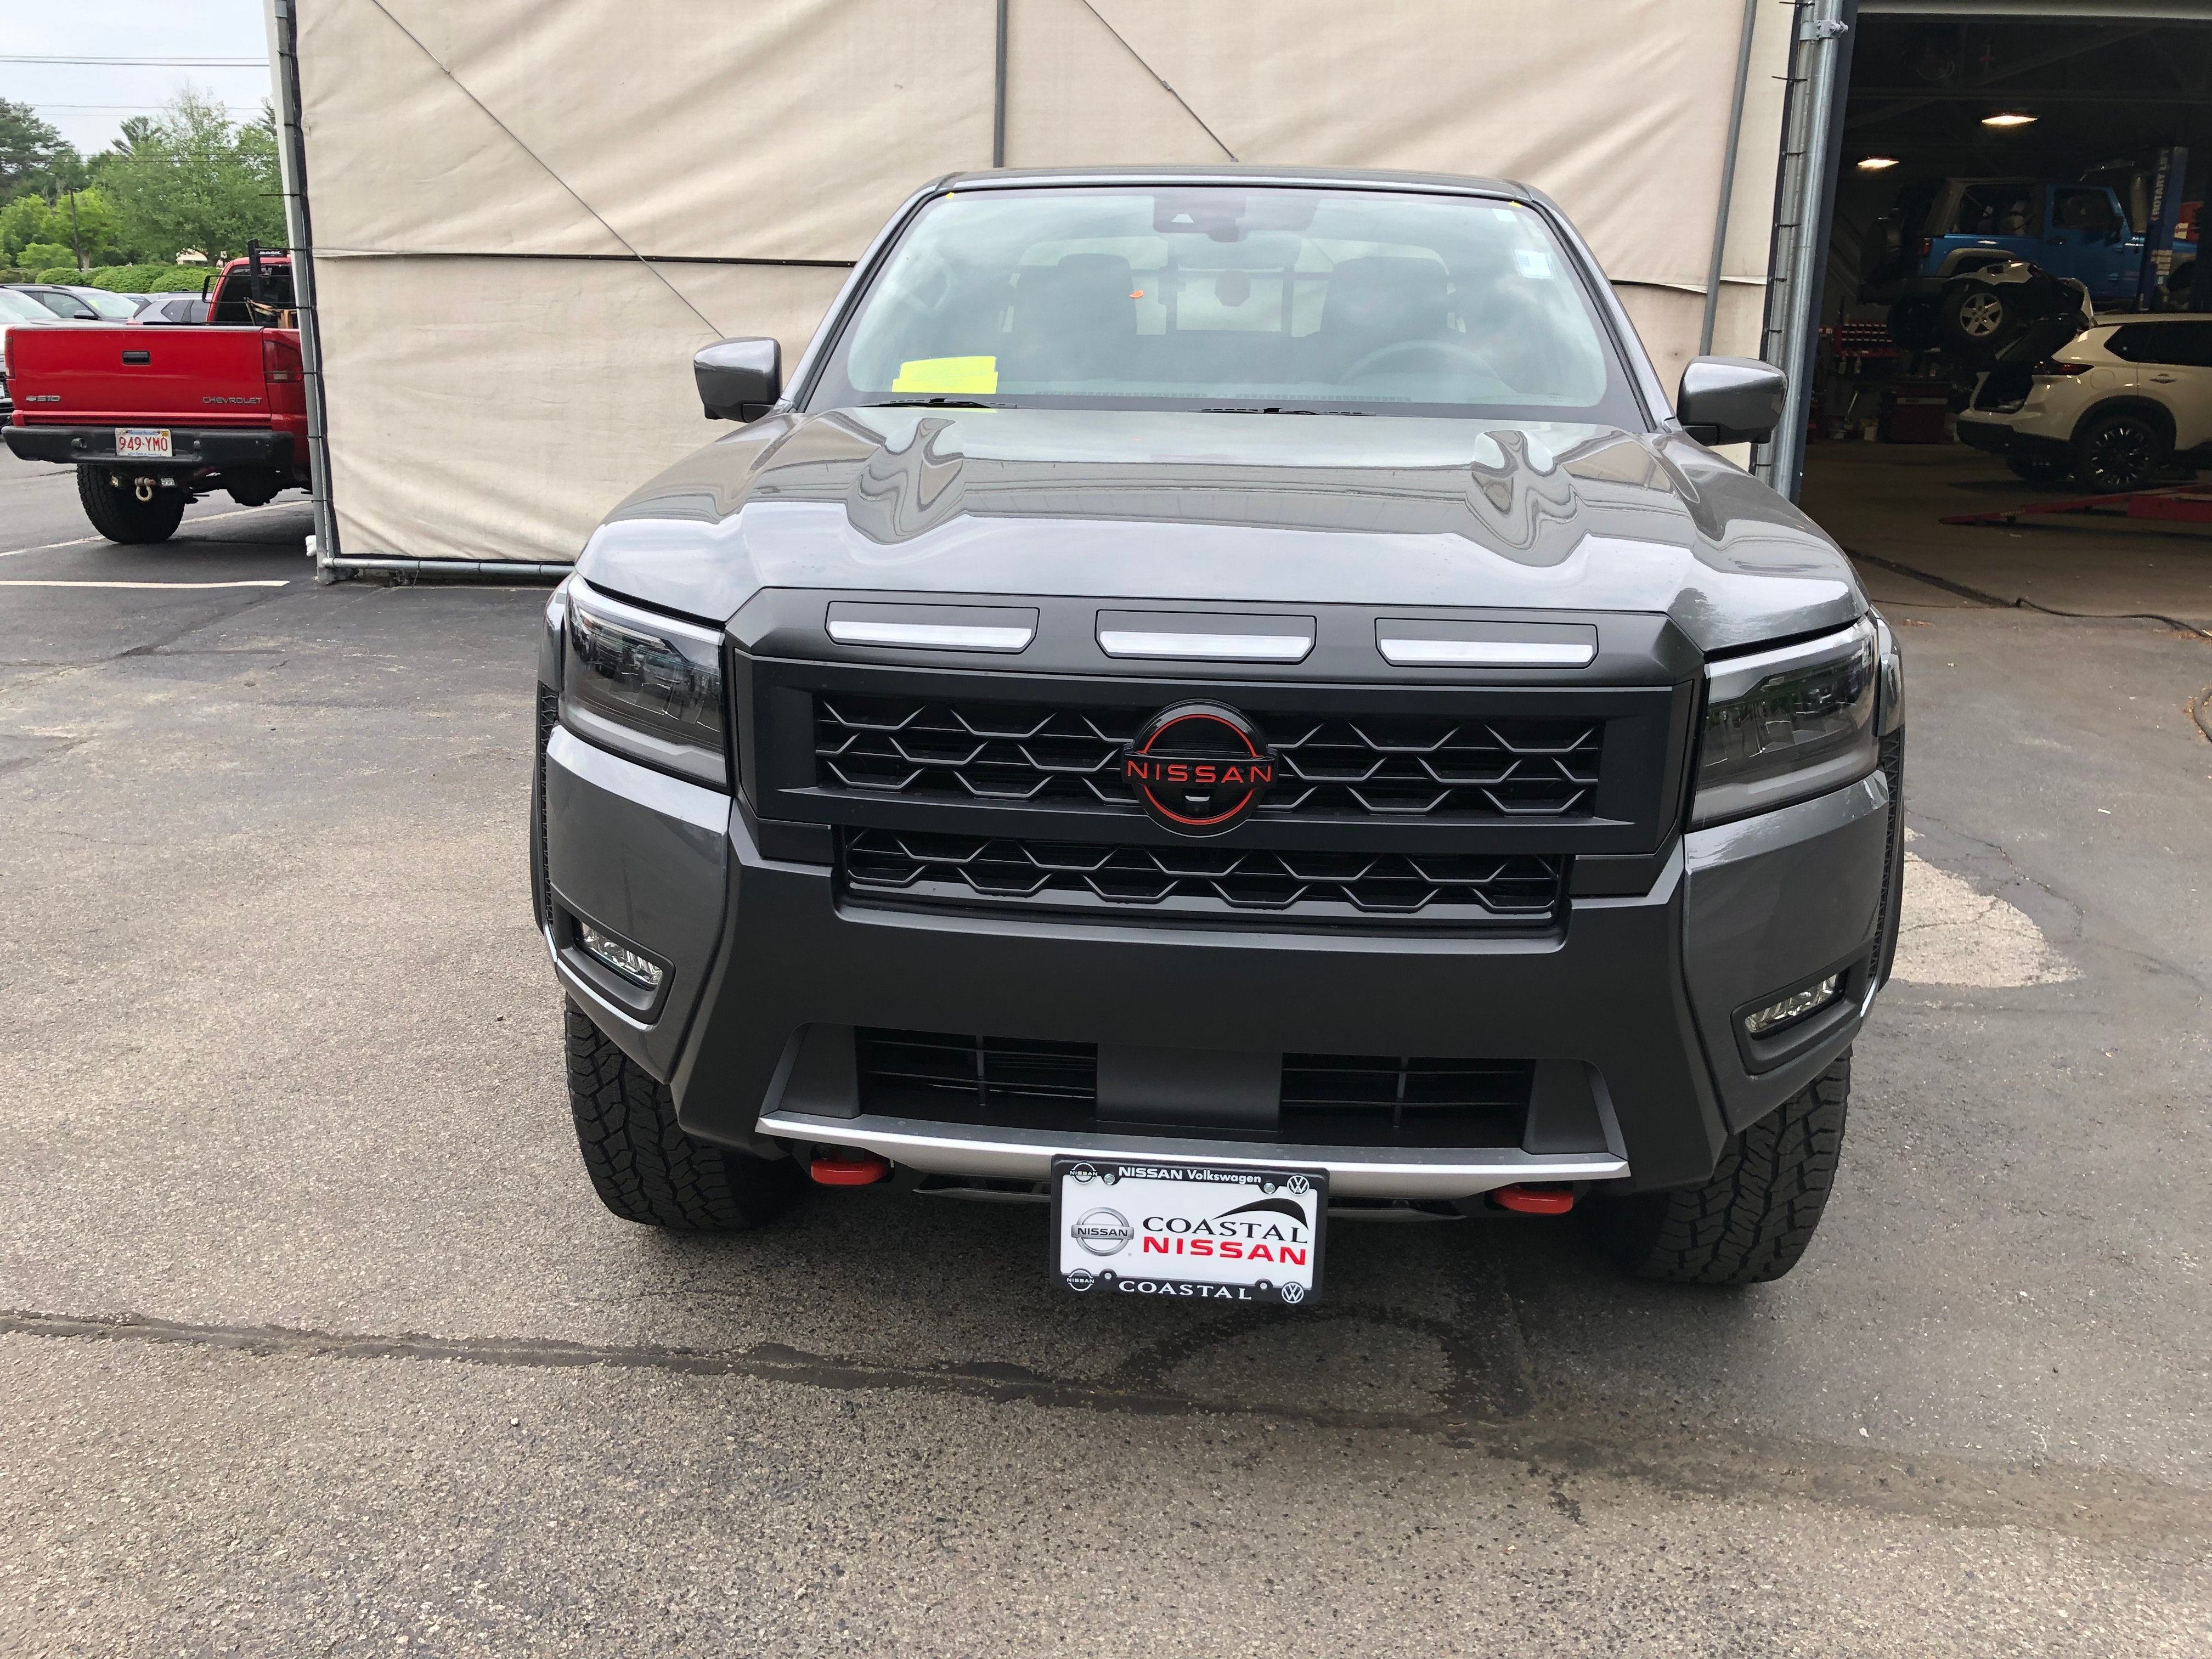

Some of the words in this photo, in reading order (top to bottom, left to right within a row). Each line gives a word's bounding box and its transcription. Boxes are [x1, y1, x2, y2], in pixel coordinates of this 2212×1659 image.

[1127, 759, 1272, 783] NISSAN
[1118, 1166, 1183, 1180] NISSAN
[1187, 1169, 1261, 1184] Volkswagen
[1077, 1227, 1128, 1237] NISSAN
[1143, 1216, 1308, 1244] COASTAL
[1143, 1236, 1306, 1265] NISSAN
[1119, 1280, 1252, 1300] COASTAL
